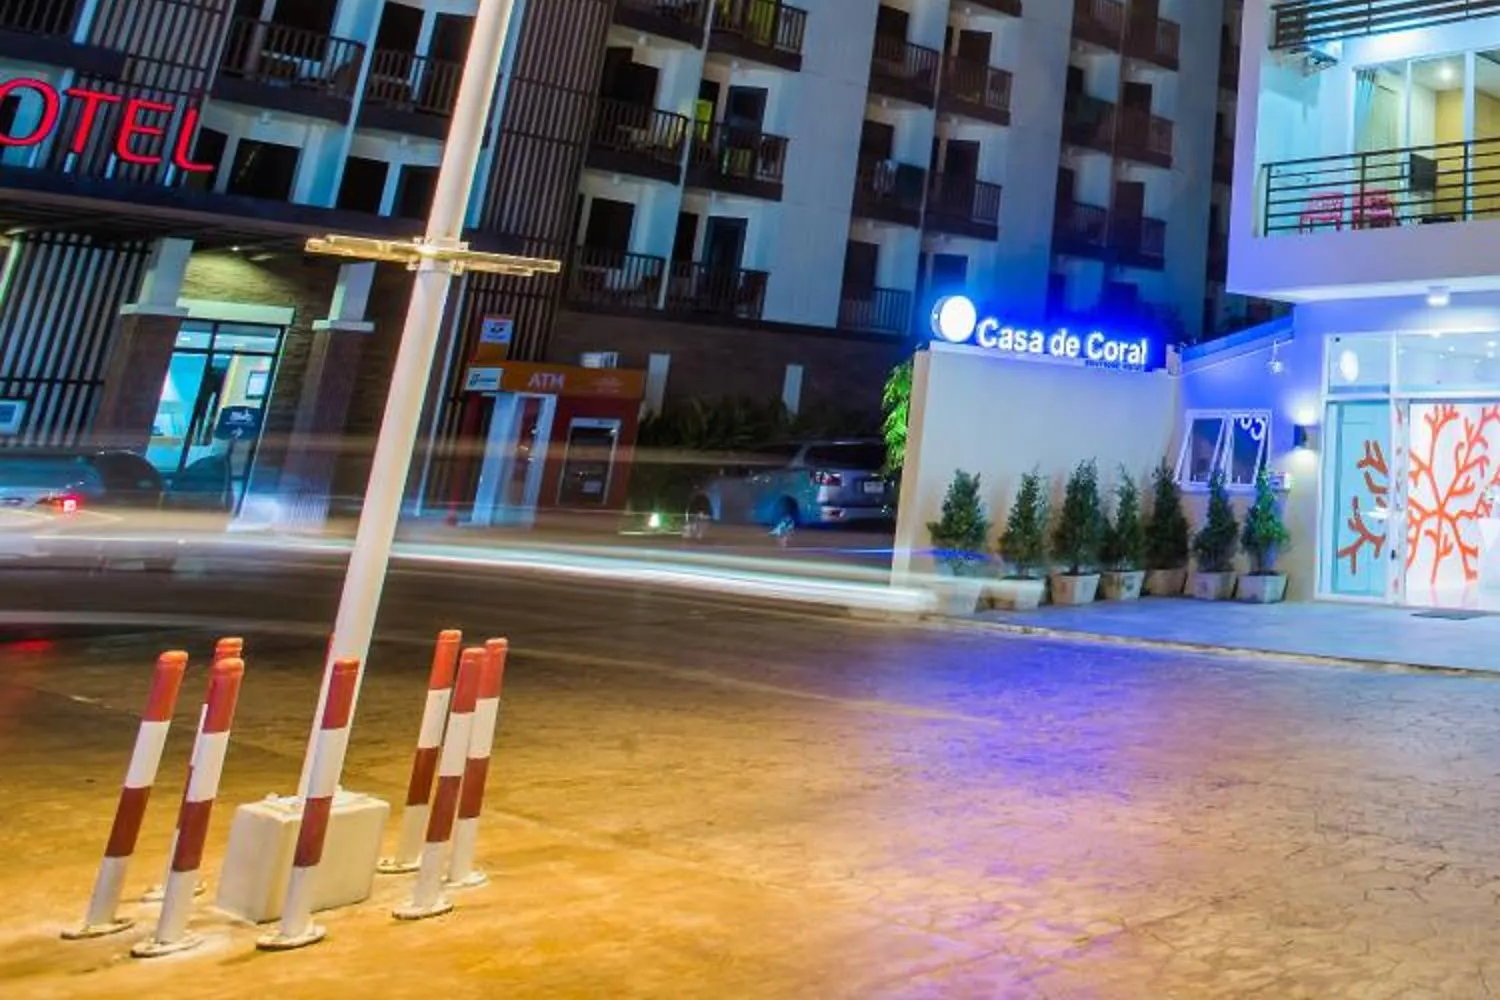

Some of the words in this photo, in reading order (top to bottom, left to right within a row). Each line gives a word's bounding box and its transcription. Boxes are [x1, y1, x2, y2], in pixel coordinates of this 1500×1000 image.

[977, 318, 1044, 353] Casa
[1051, 329, 1081, 358] de
[1087, 333, 1147, 365] Coral
[528, 372, 565, 389] ATM
